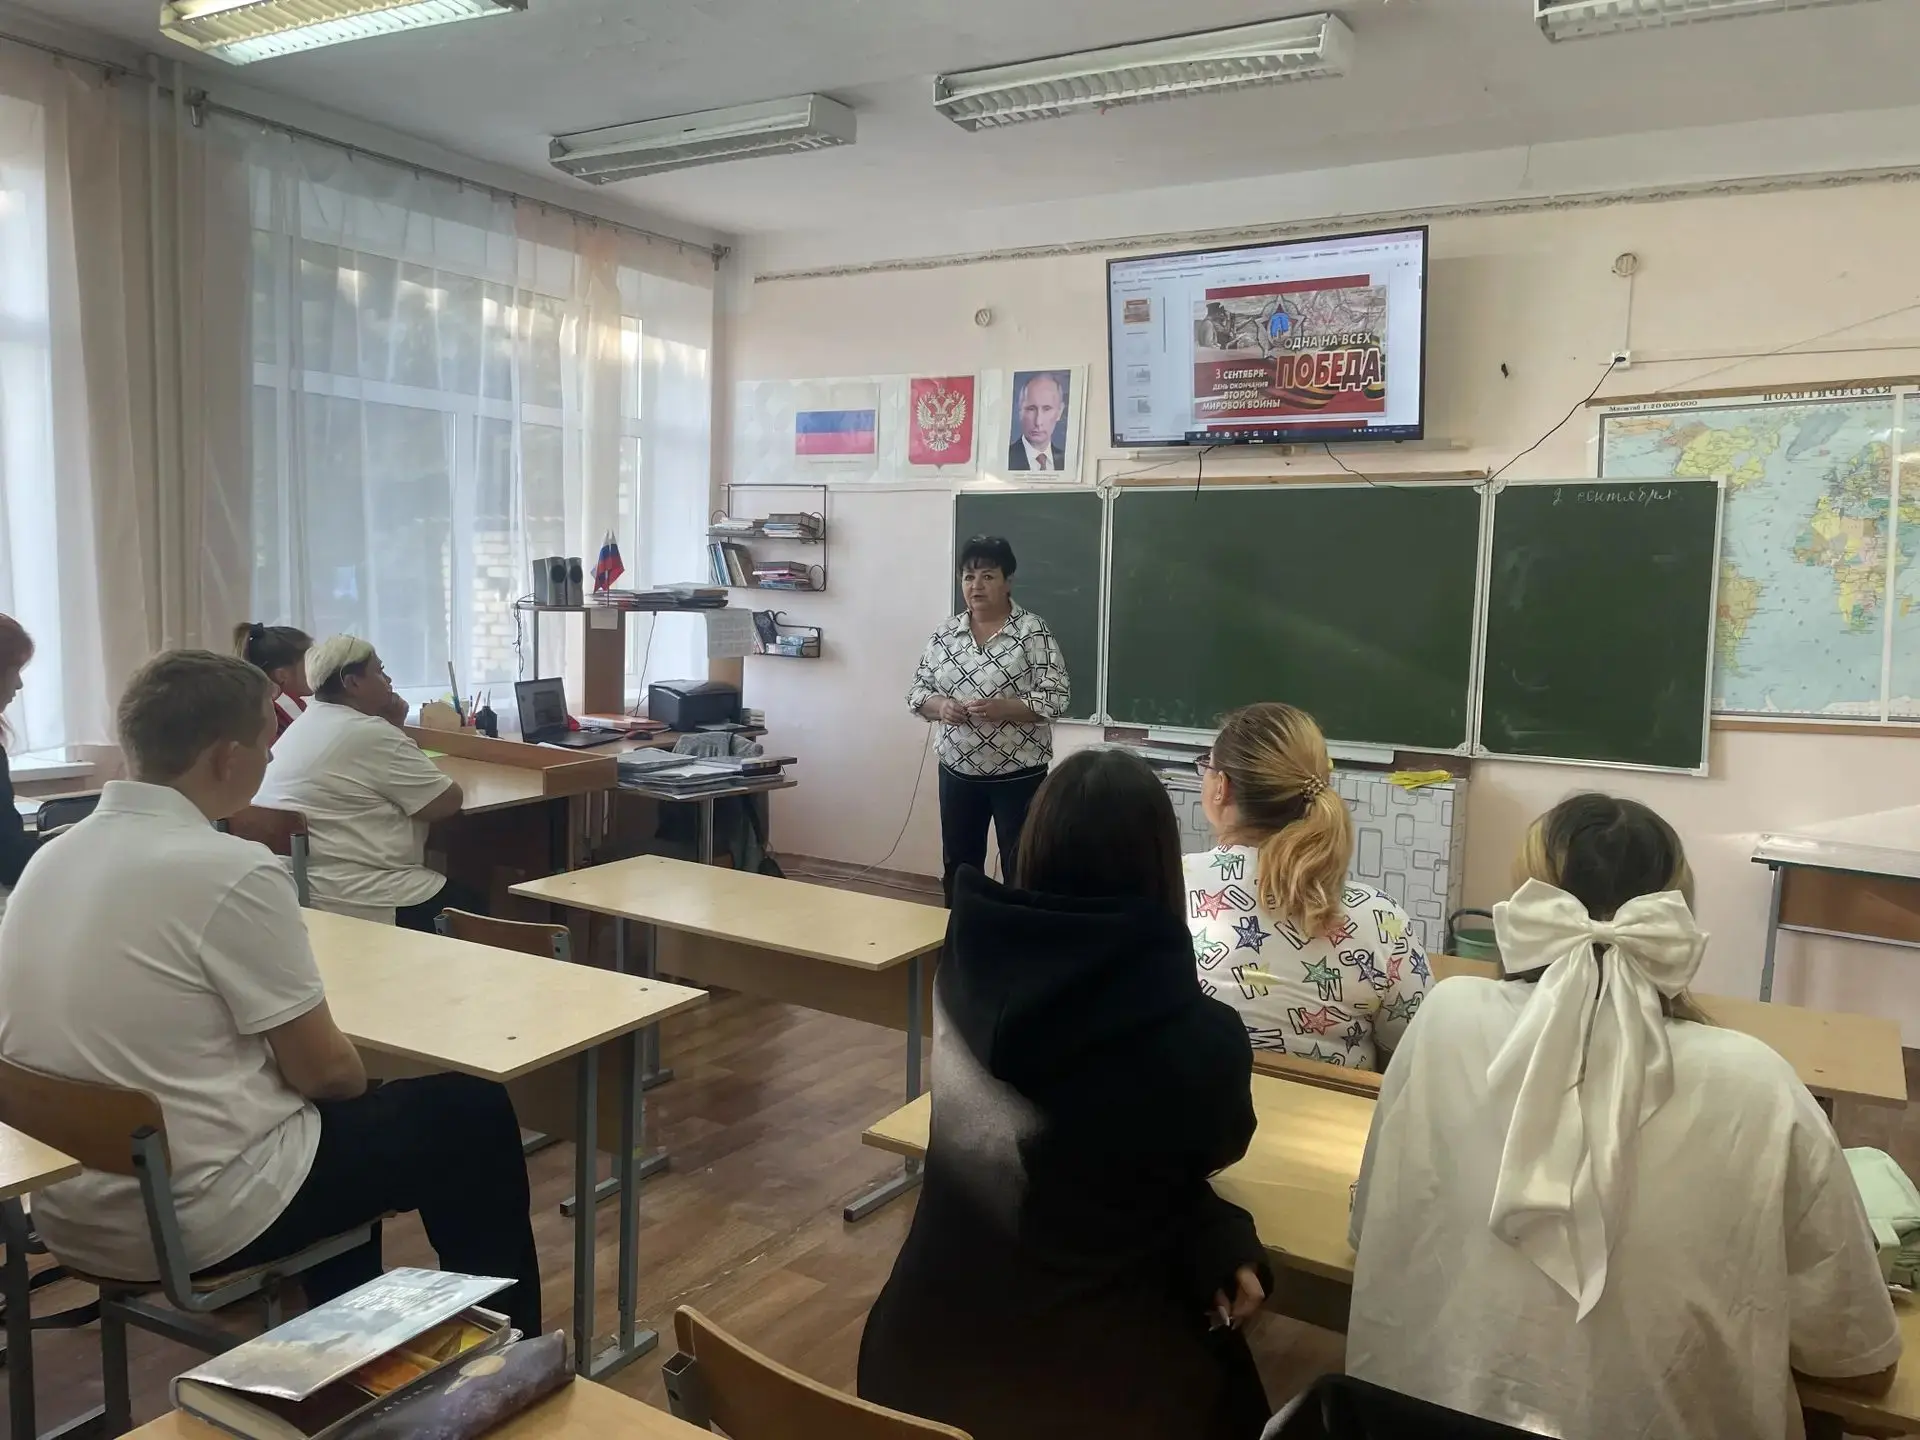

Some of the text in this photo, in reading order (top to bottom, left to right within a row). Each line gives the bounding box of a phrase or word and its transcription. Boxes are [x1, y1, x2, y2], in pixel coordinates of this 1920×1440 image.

[1285, 332, 1372, 349] ОДНА НА ВСЕХ
[1275, 348, 1382, 392] ПОБЕДА
[1223, 389, 1258, 399] ВТОРОЙ
[1202, 399, 1246, 410] МИРОВОЙ
